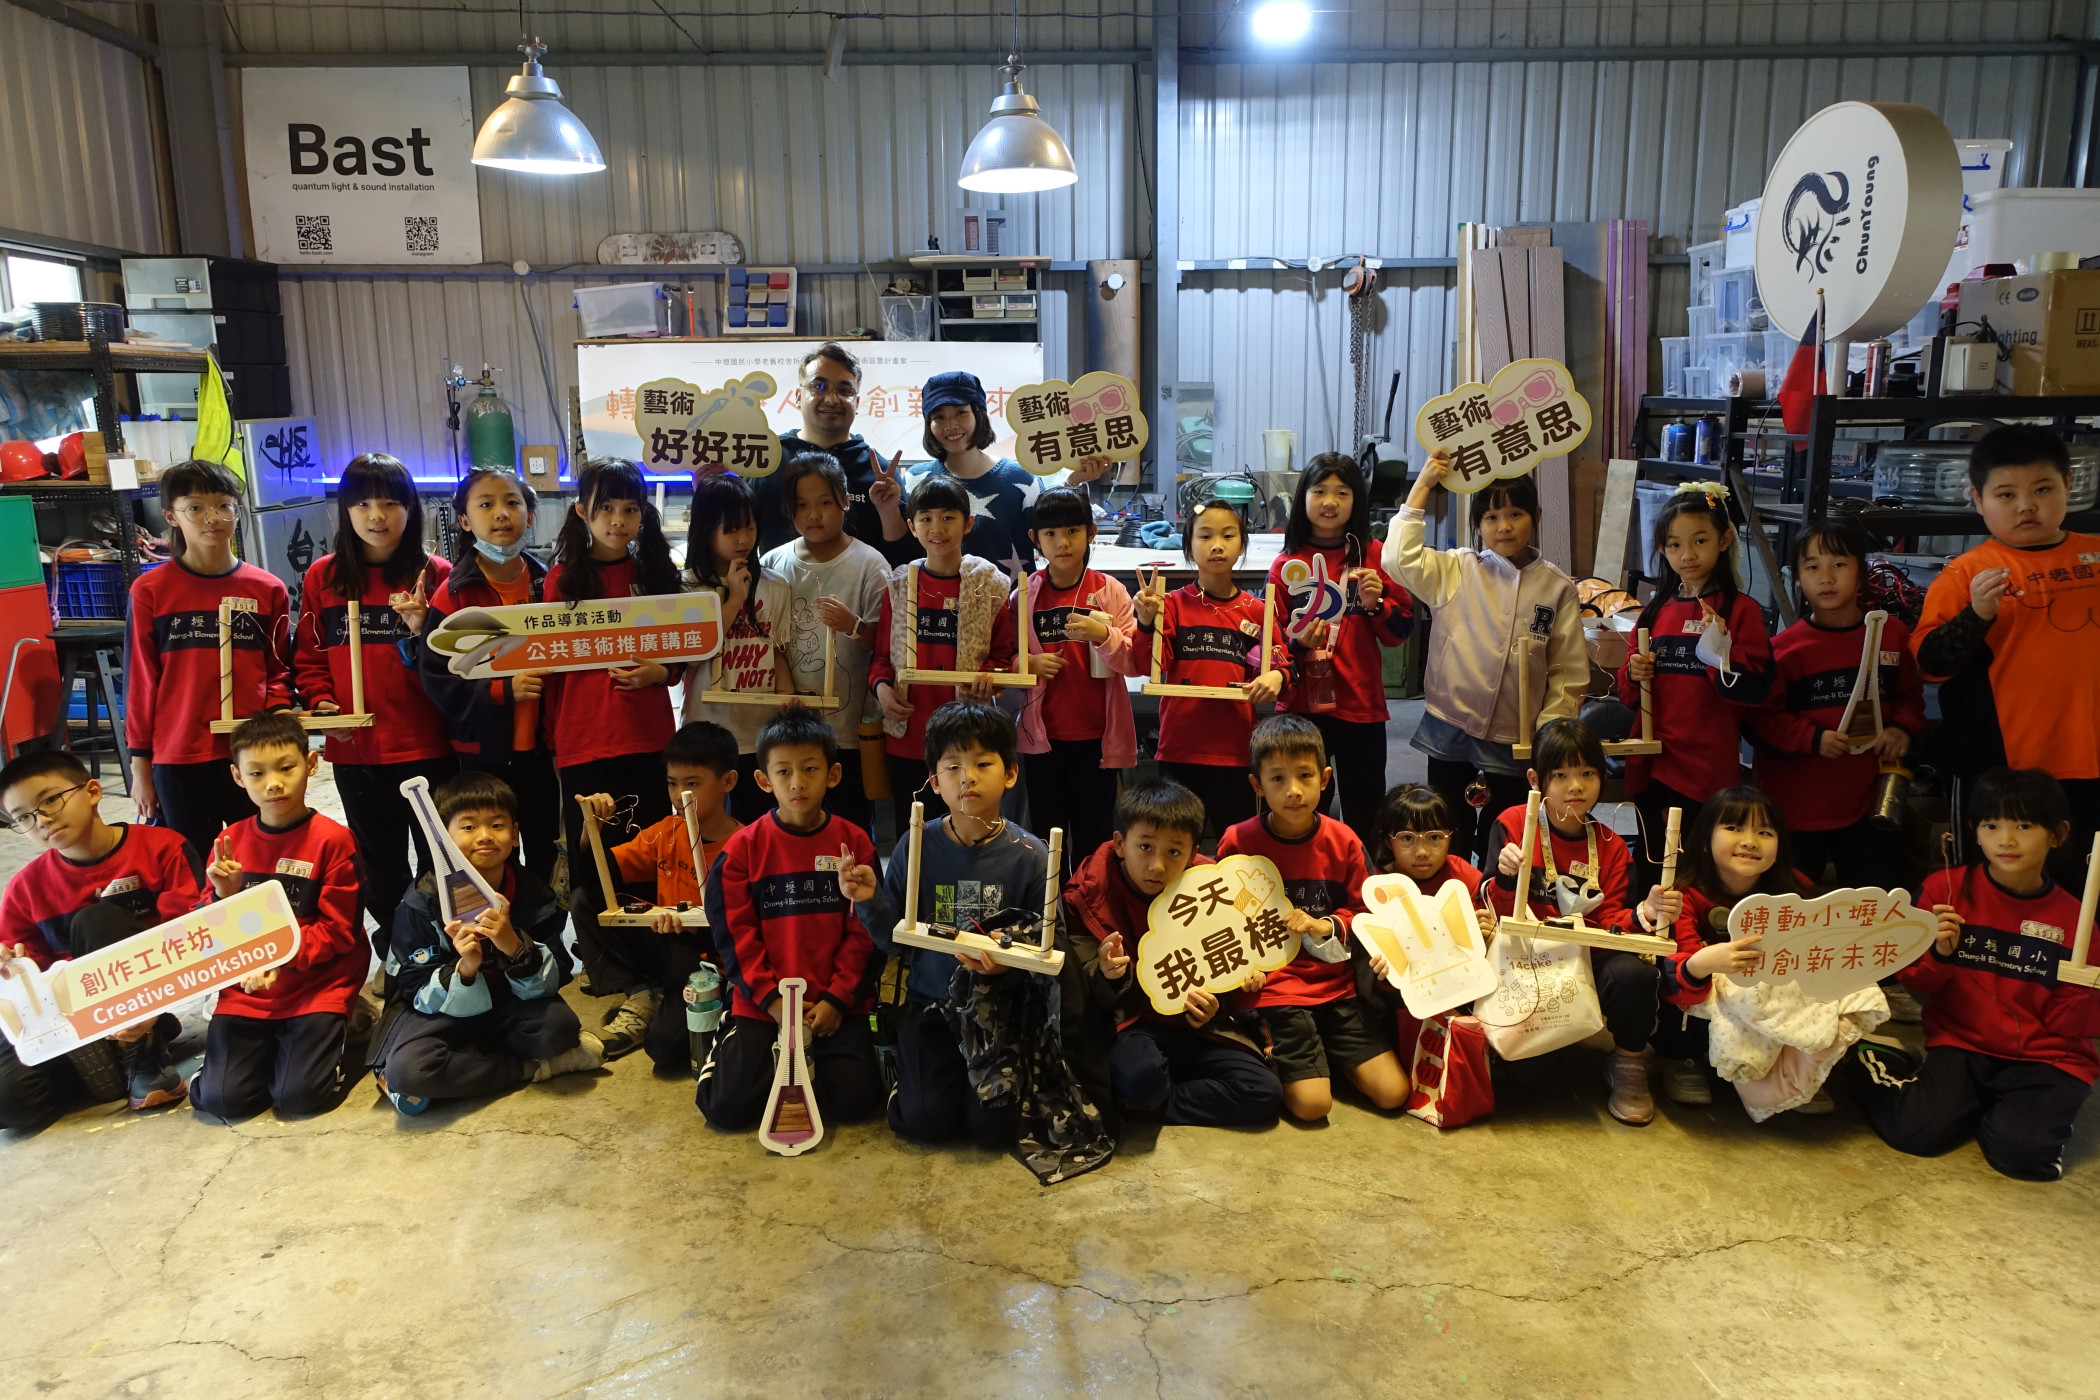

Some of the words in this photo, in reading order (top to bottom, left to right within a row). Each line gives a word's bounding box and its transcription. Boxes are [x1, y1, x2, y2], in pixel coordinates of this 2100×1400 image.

[288, 123, 434, 176] Bast
[292, 183, 330, 192] quantum
[332, 183, 350, 192] light
[361, 183, 386, 191] sound
[389, 183, 435, 191] installation
[1856, 155, 1880, 274] ChunYoung
[644, 390, 694, 415] 藝術
[1018, 391, 1070, 423] 藝術
[1428, 394, 1492, 443] 藝術
[651, 427, 769, 468] 好好玩
[1028, 415, 1139, 464] 有意思
[1451, 400, 1582, 483] 有意思
[848, 494, 865, 503] ast
[171, 616, 250, 629] 中壢小
[524, 610, 621, 630] 作品導賞活動
[1530, 604, 1555, 636] R
[527, 630, 703, 660] 公共藝術推廣講座
[722, 644, 768, 670] WHY
[1206, 646, 1235, 656] Elementary
[1656, 661, 1689, 669] Elementary
[1167, 878, 1234, 927] 今天
[1740, 899, 1906, 935] 轉動小壢人
[80, 925, 215, 998] 創作工作坊
[1154, 908, 1290, 999] 我最棒
[1509, 960, 1552, 970] 14cake
[1988, 956, 2022, 972] Elementary
[92, 983, 176, 1025] Creative
[176, 940, 279, 991] Workshop
